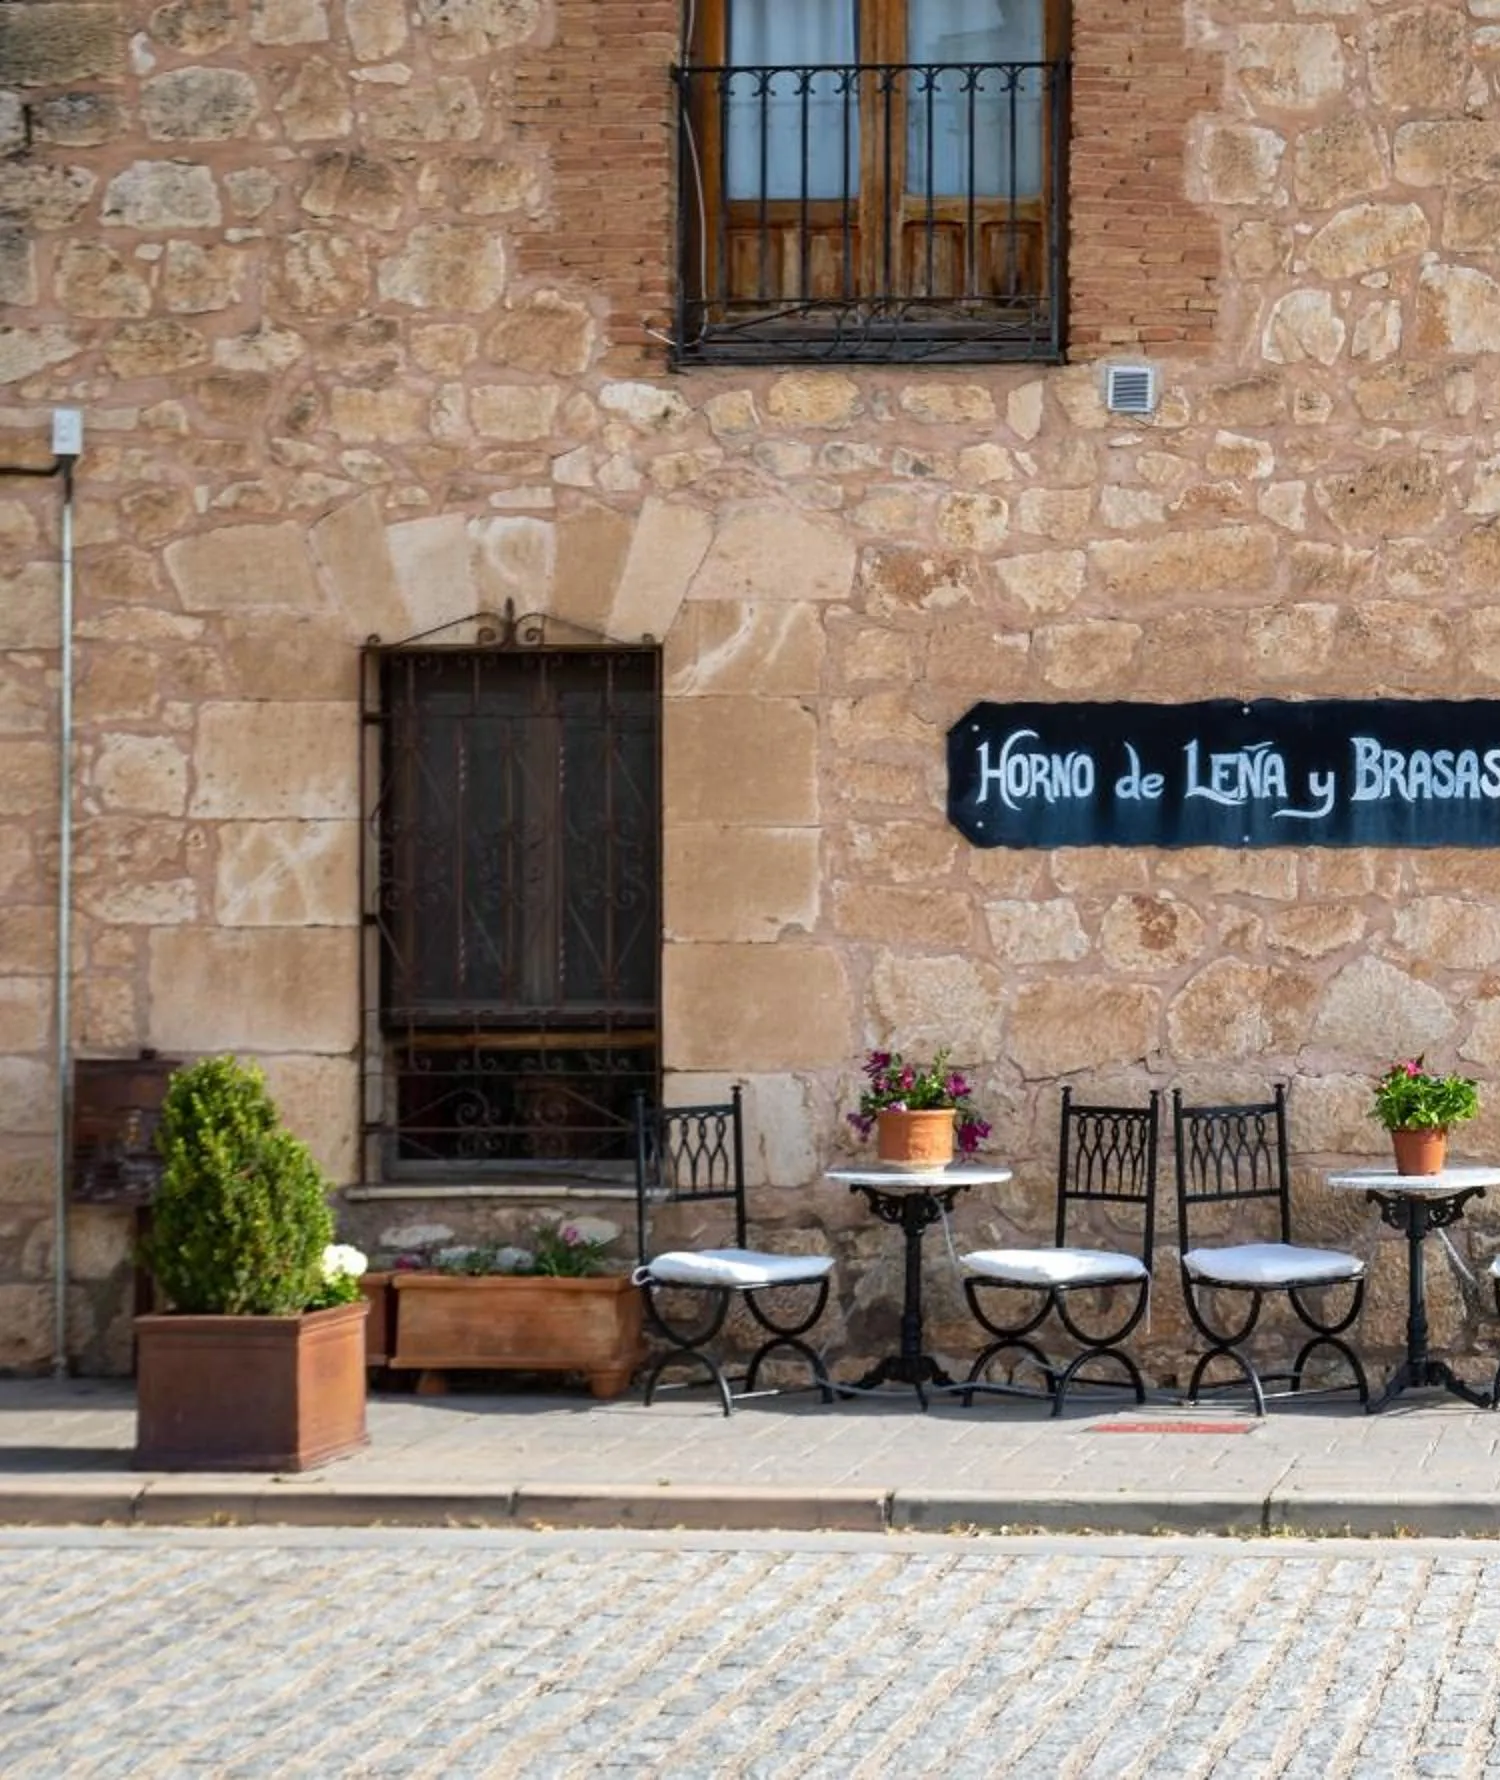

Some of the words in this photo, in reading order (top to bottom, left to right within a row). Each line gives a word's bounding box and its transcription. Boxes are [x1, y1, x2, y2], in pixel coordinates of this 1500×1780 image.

[976, 730, 1095, 811] HORNO
[1115, 741, 1164, 800] de
[1184, 739, 1288, 806] LEÑA
[1272, 771, 1335, 819] y
